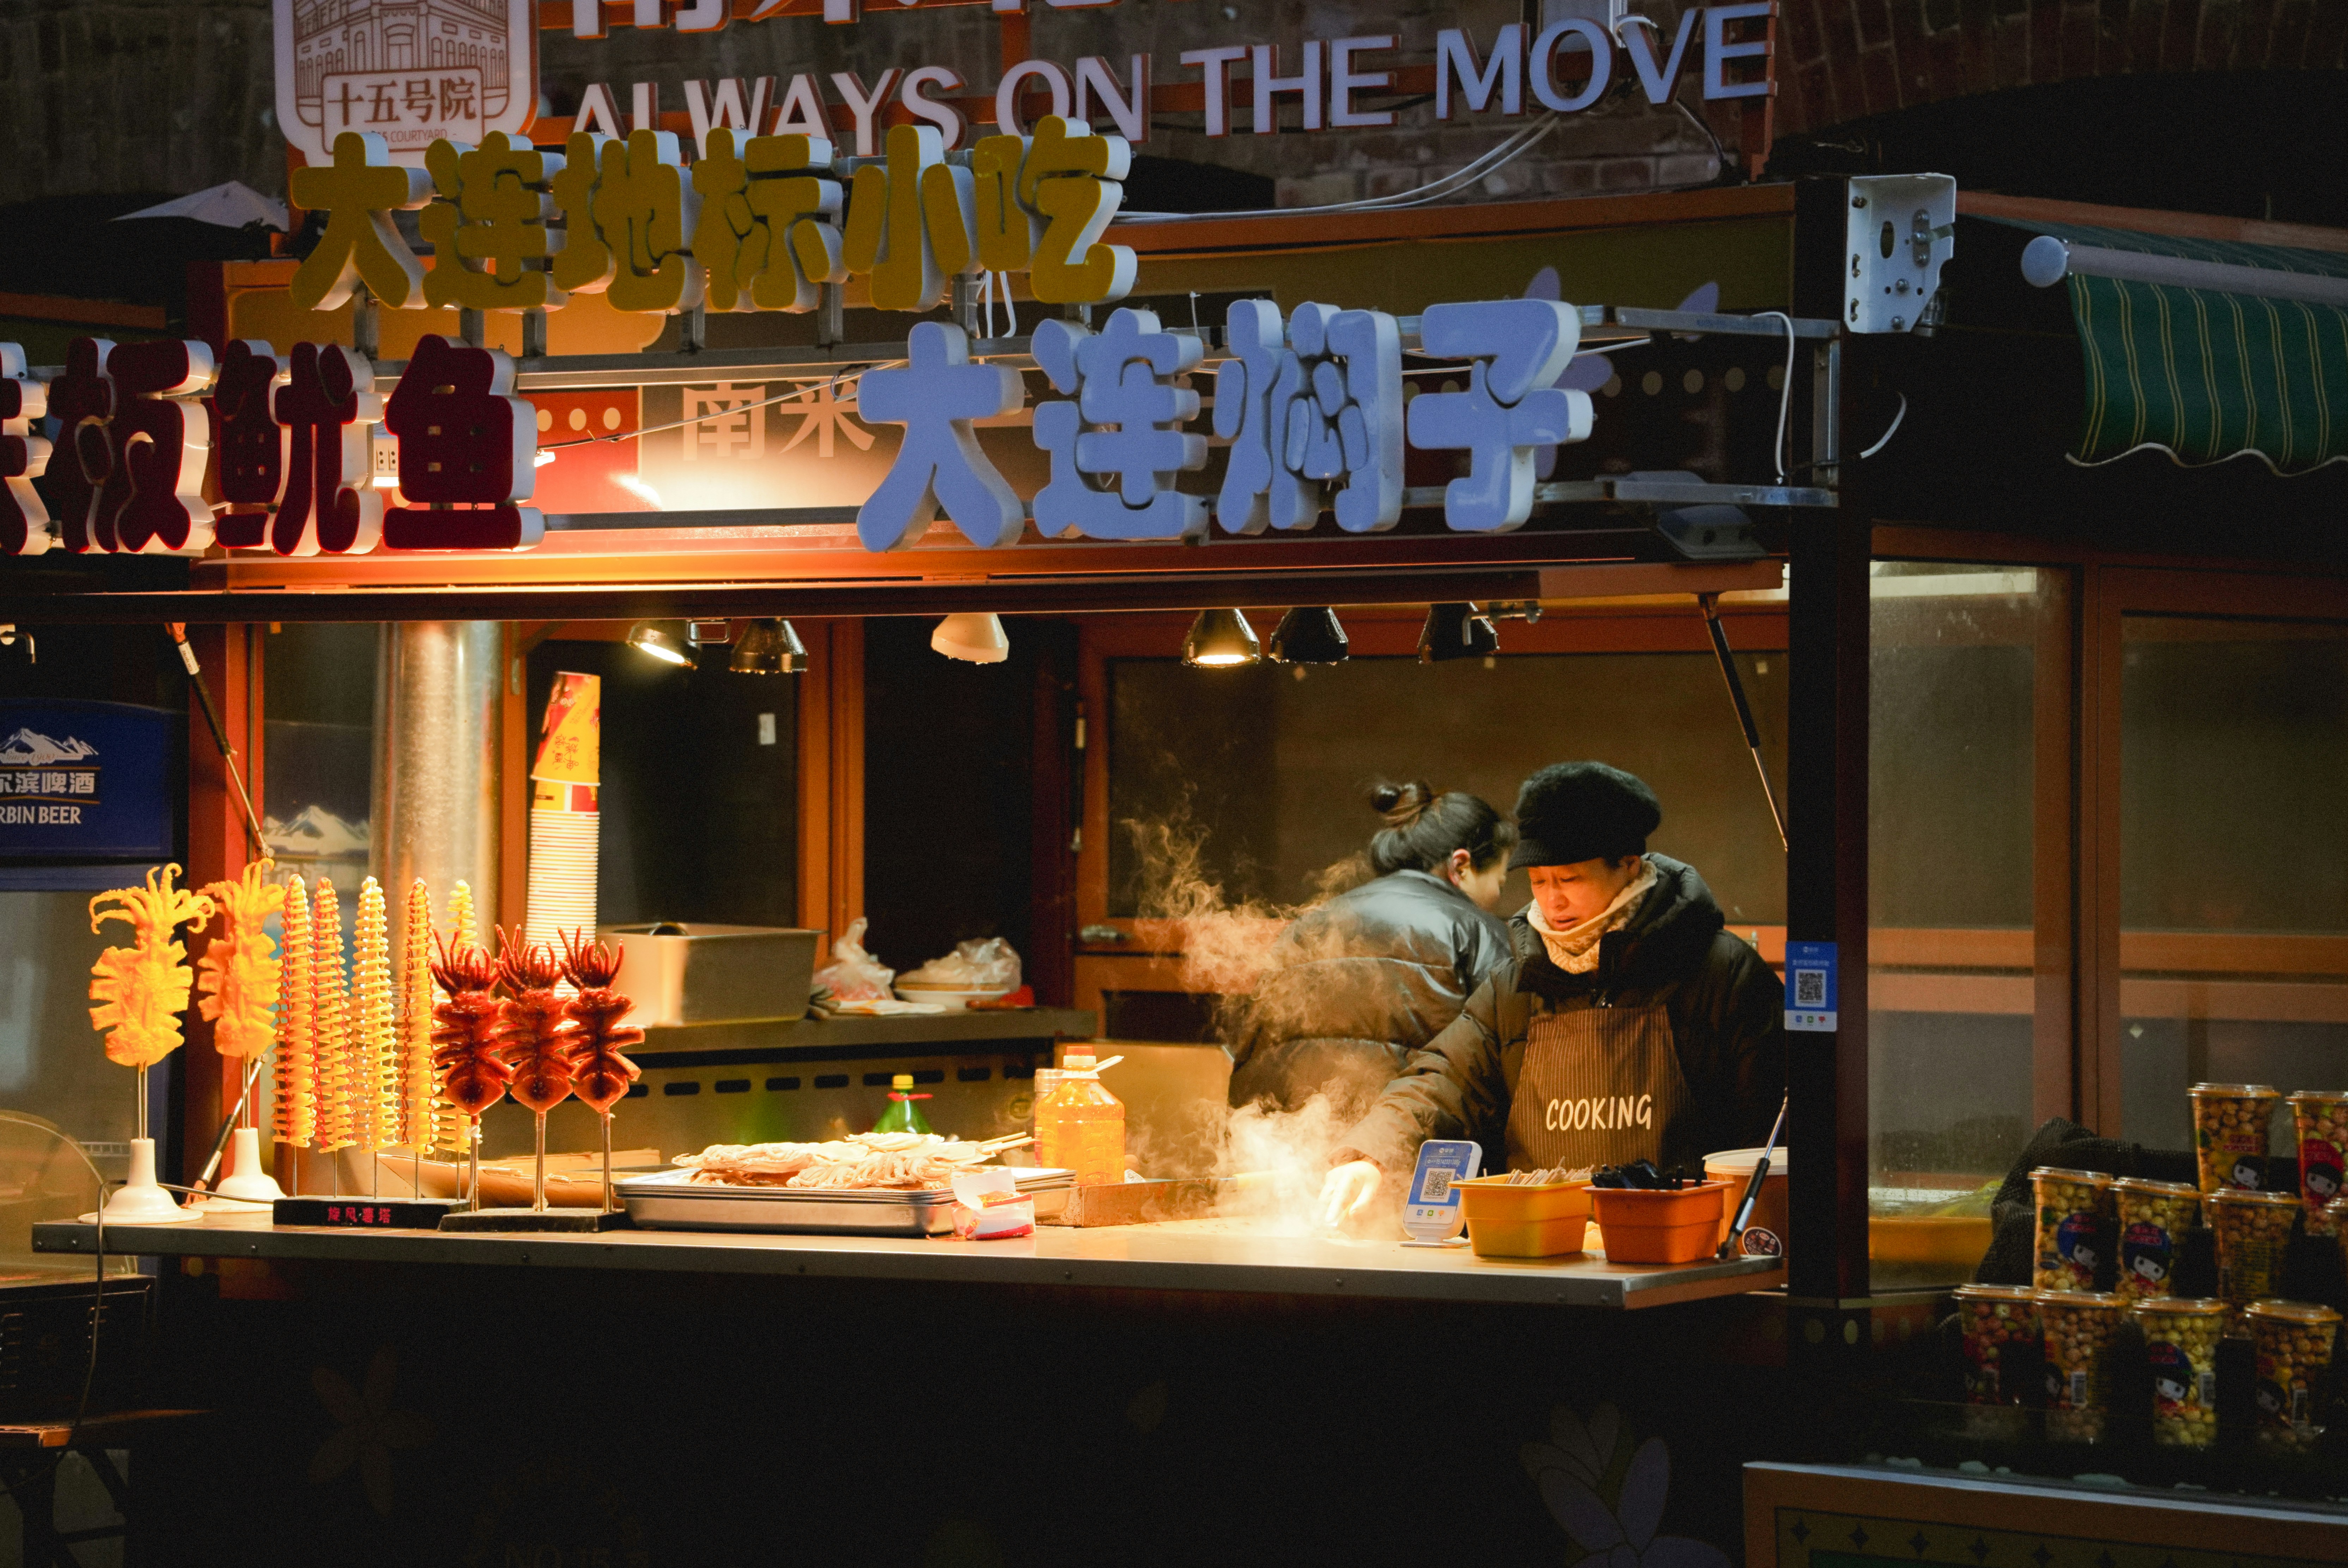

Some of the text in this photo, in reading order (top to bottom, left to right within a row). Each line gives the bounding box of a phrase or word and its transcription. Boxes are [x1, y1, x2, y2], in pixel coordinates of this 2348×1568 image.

[995, 53, 1150, 144] ON
[1180, 34, 1401, 138] THE
[1435, 2, 1778, 120] MOVE
[328, 76, 477, 126] 十五号院
[390, 129, 447, 142] COURTYARD
[290, 115, 1137, 312] 大连地标小吃
[856, 298, 1593, 552] 大连焖子
[39, 806, 81, 824] BEER
[1546, 1094, 1652, 1131] COOKING
